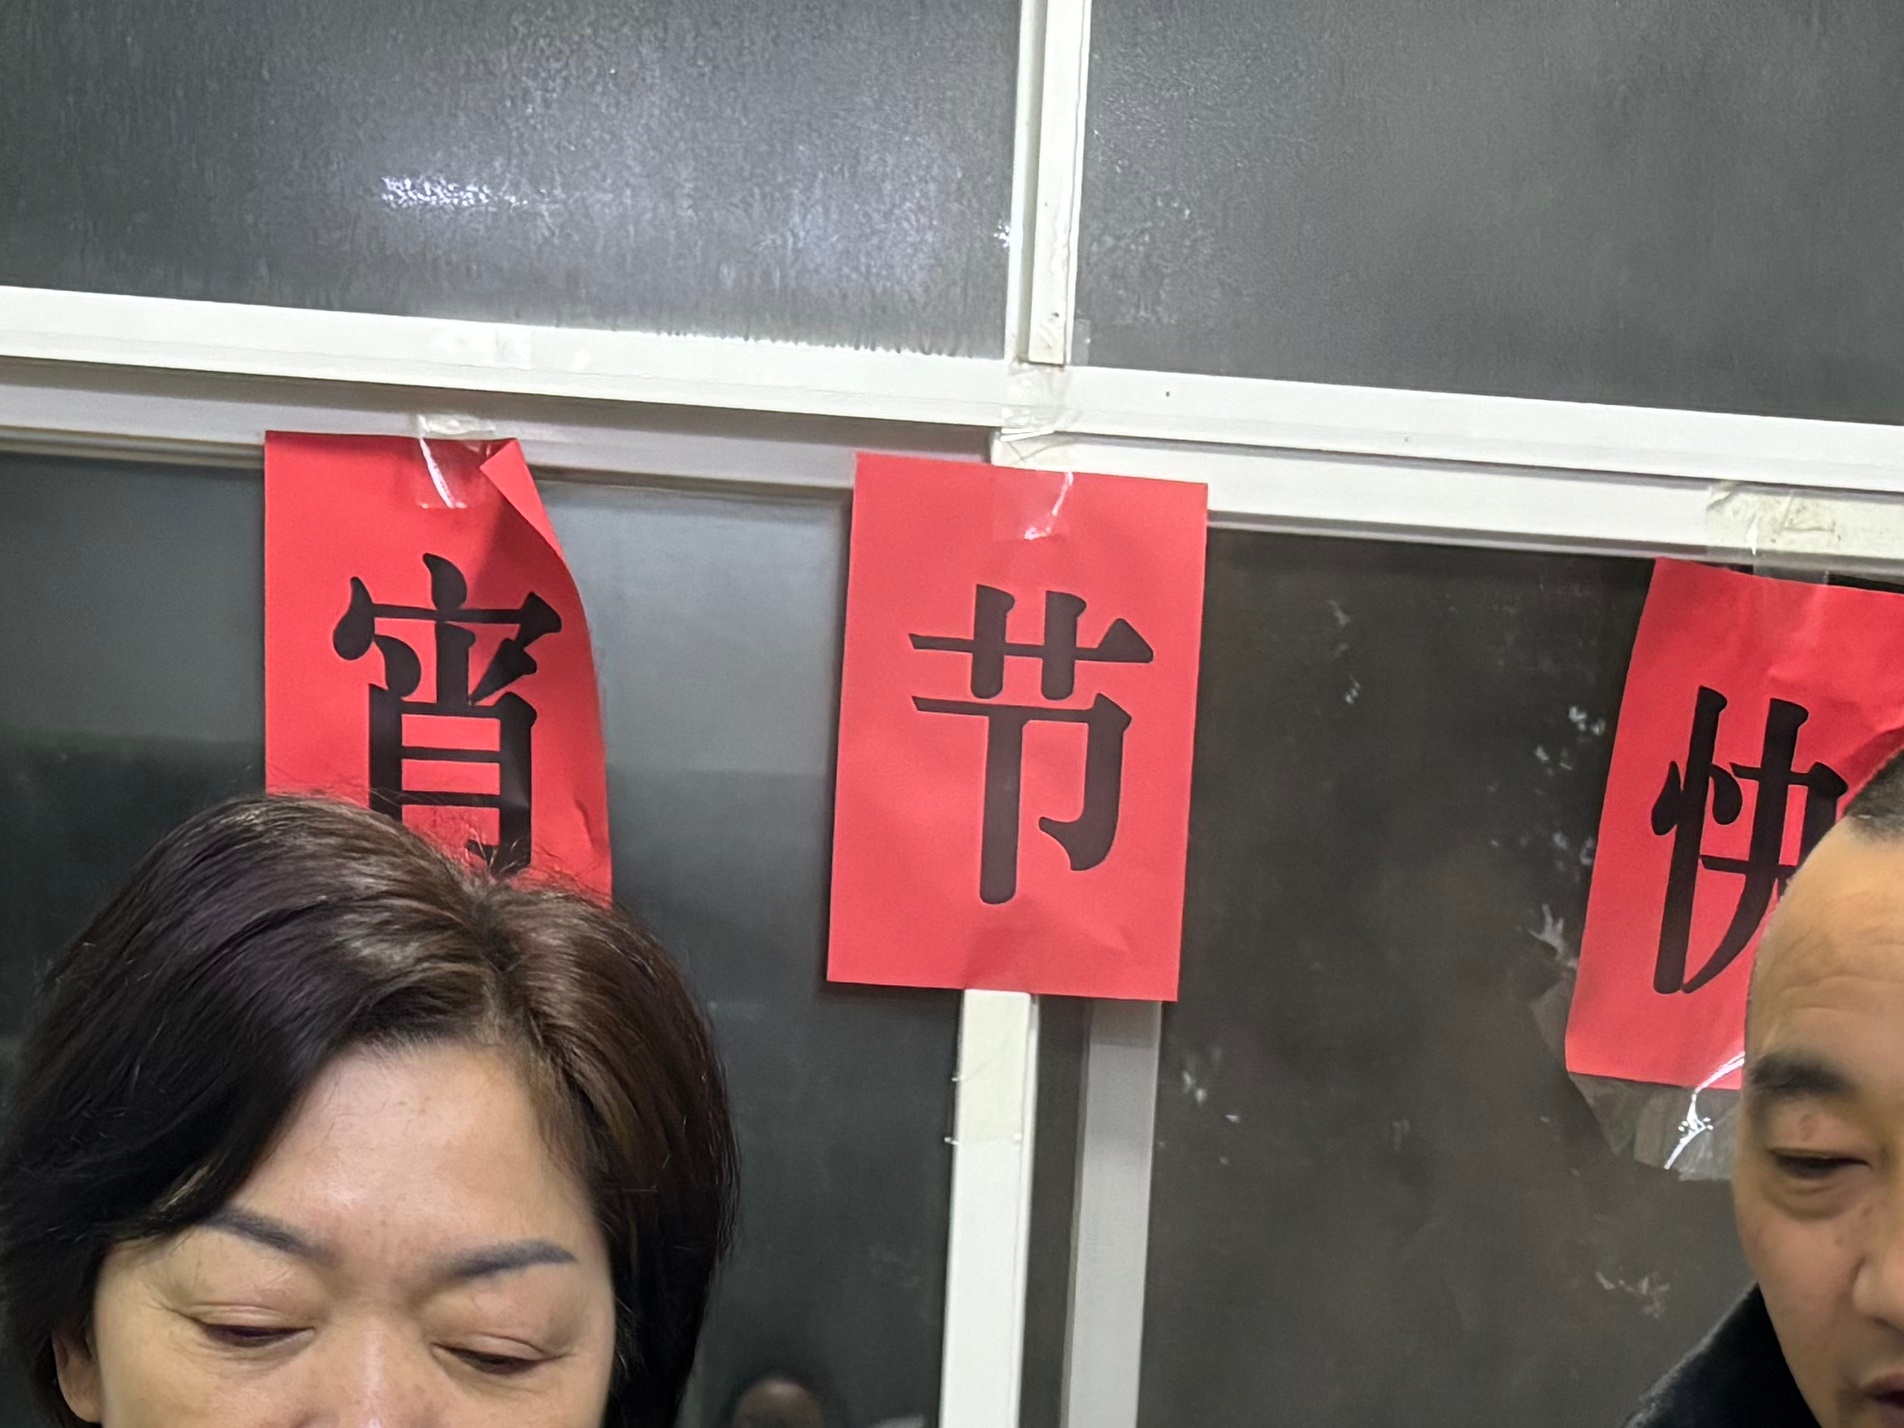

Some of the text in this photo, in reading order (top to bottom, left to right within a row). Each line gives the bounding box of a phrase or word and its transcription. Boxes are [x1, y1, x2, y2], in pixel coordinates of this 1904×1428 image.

[334, 554, 562, 878] 宵
[913, 586, 1153, 904] 节
[1652, 686, 1848, 994] 快
